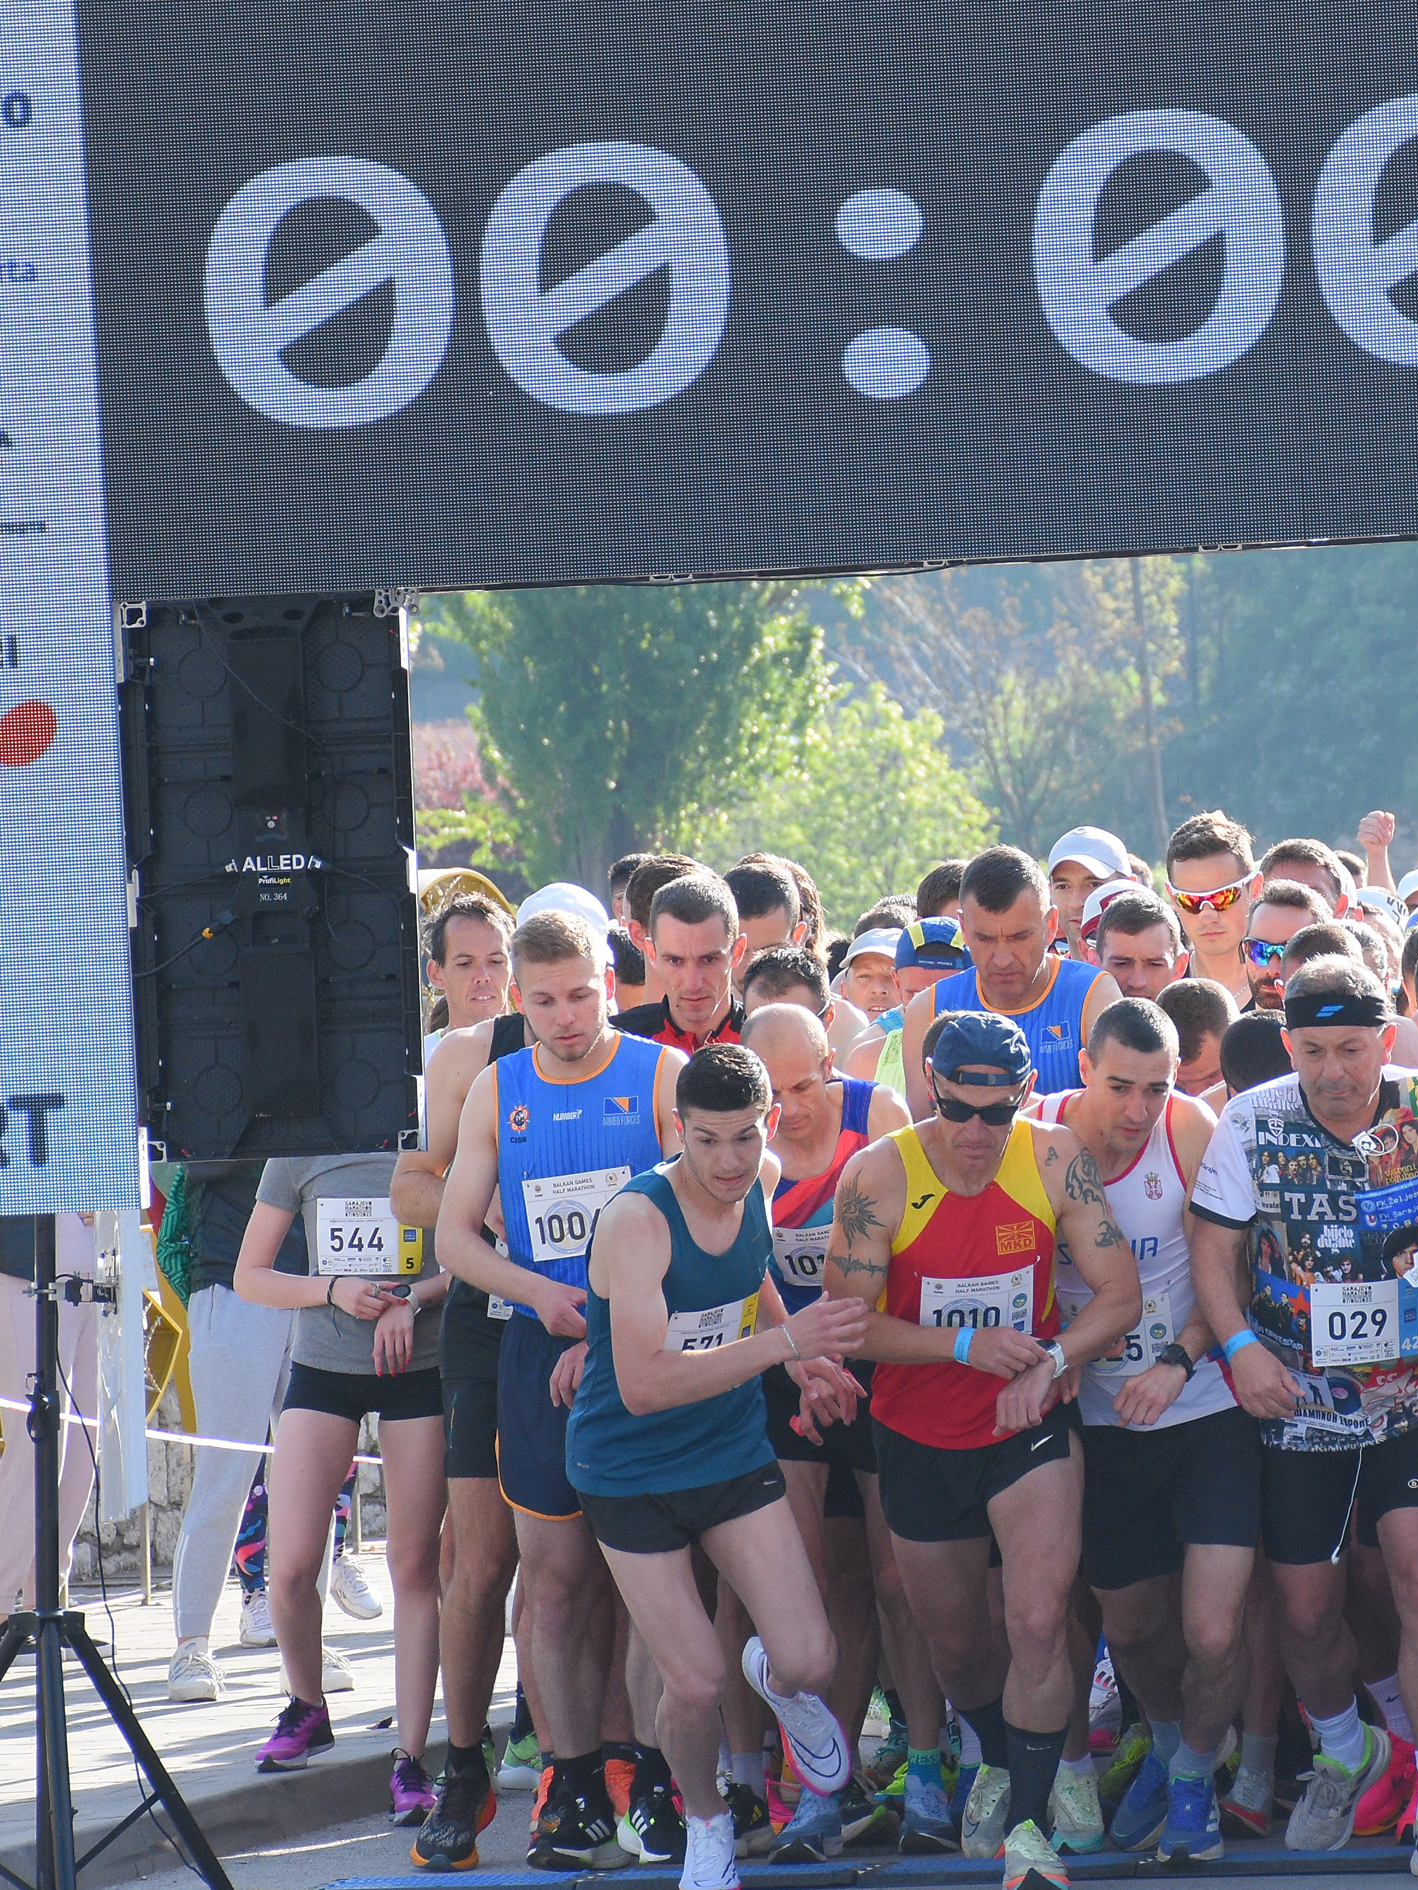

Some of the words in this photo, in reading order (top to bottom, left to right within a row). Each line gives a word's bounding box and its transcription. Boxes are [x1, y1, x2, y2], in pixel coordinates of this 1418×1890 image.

[242, 854, 305, 872] ALLED
[273, 892, 287, 901] 364
[621, 1114, 640, 1126] FORCES
[567, 1184, 595, 1193] MARATHON
[330, 1227, 385, 1252] 544
[1000, 1237, 1033, 1254] MKD
[405, 1257, 415, 1270] 5
[933, 1306, 1001, 1329] 1010
[1328, 1308, 1388, 1341] 029
[681, 1332, 724, 1351] 571
